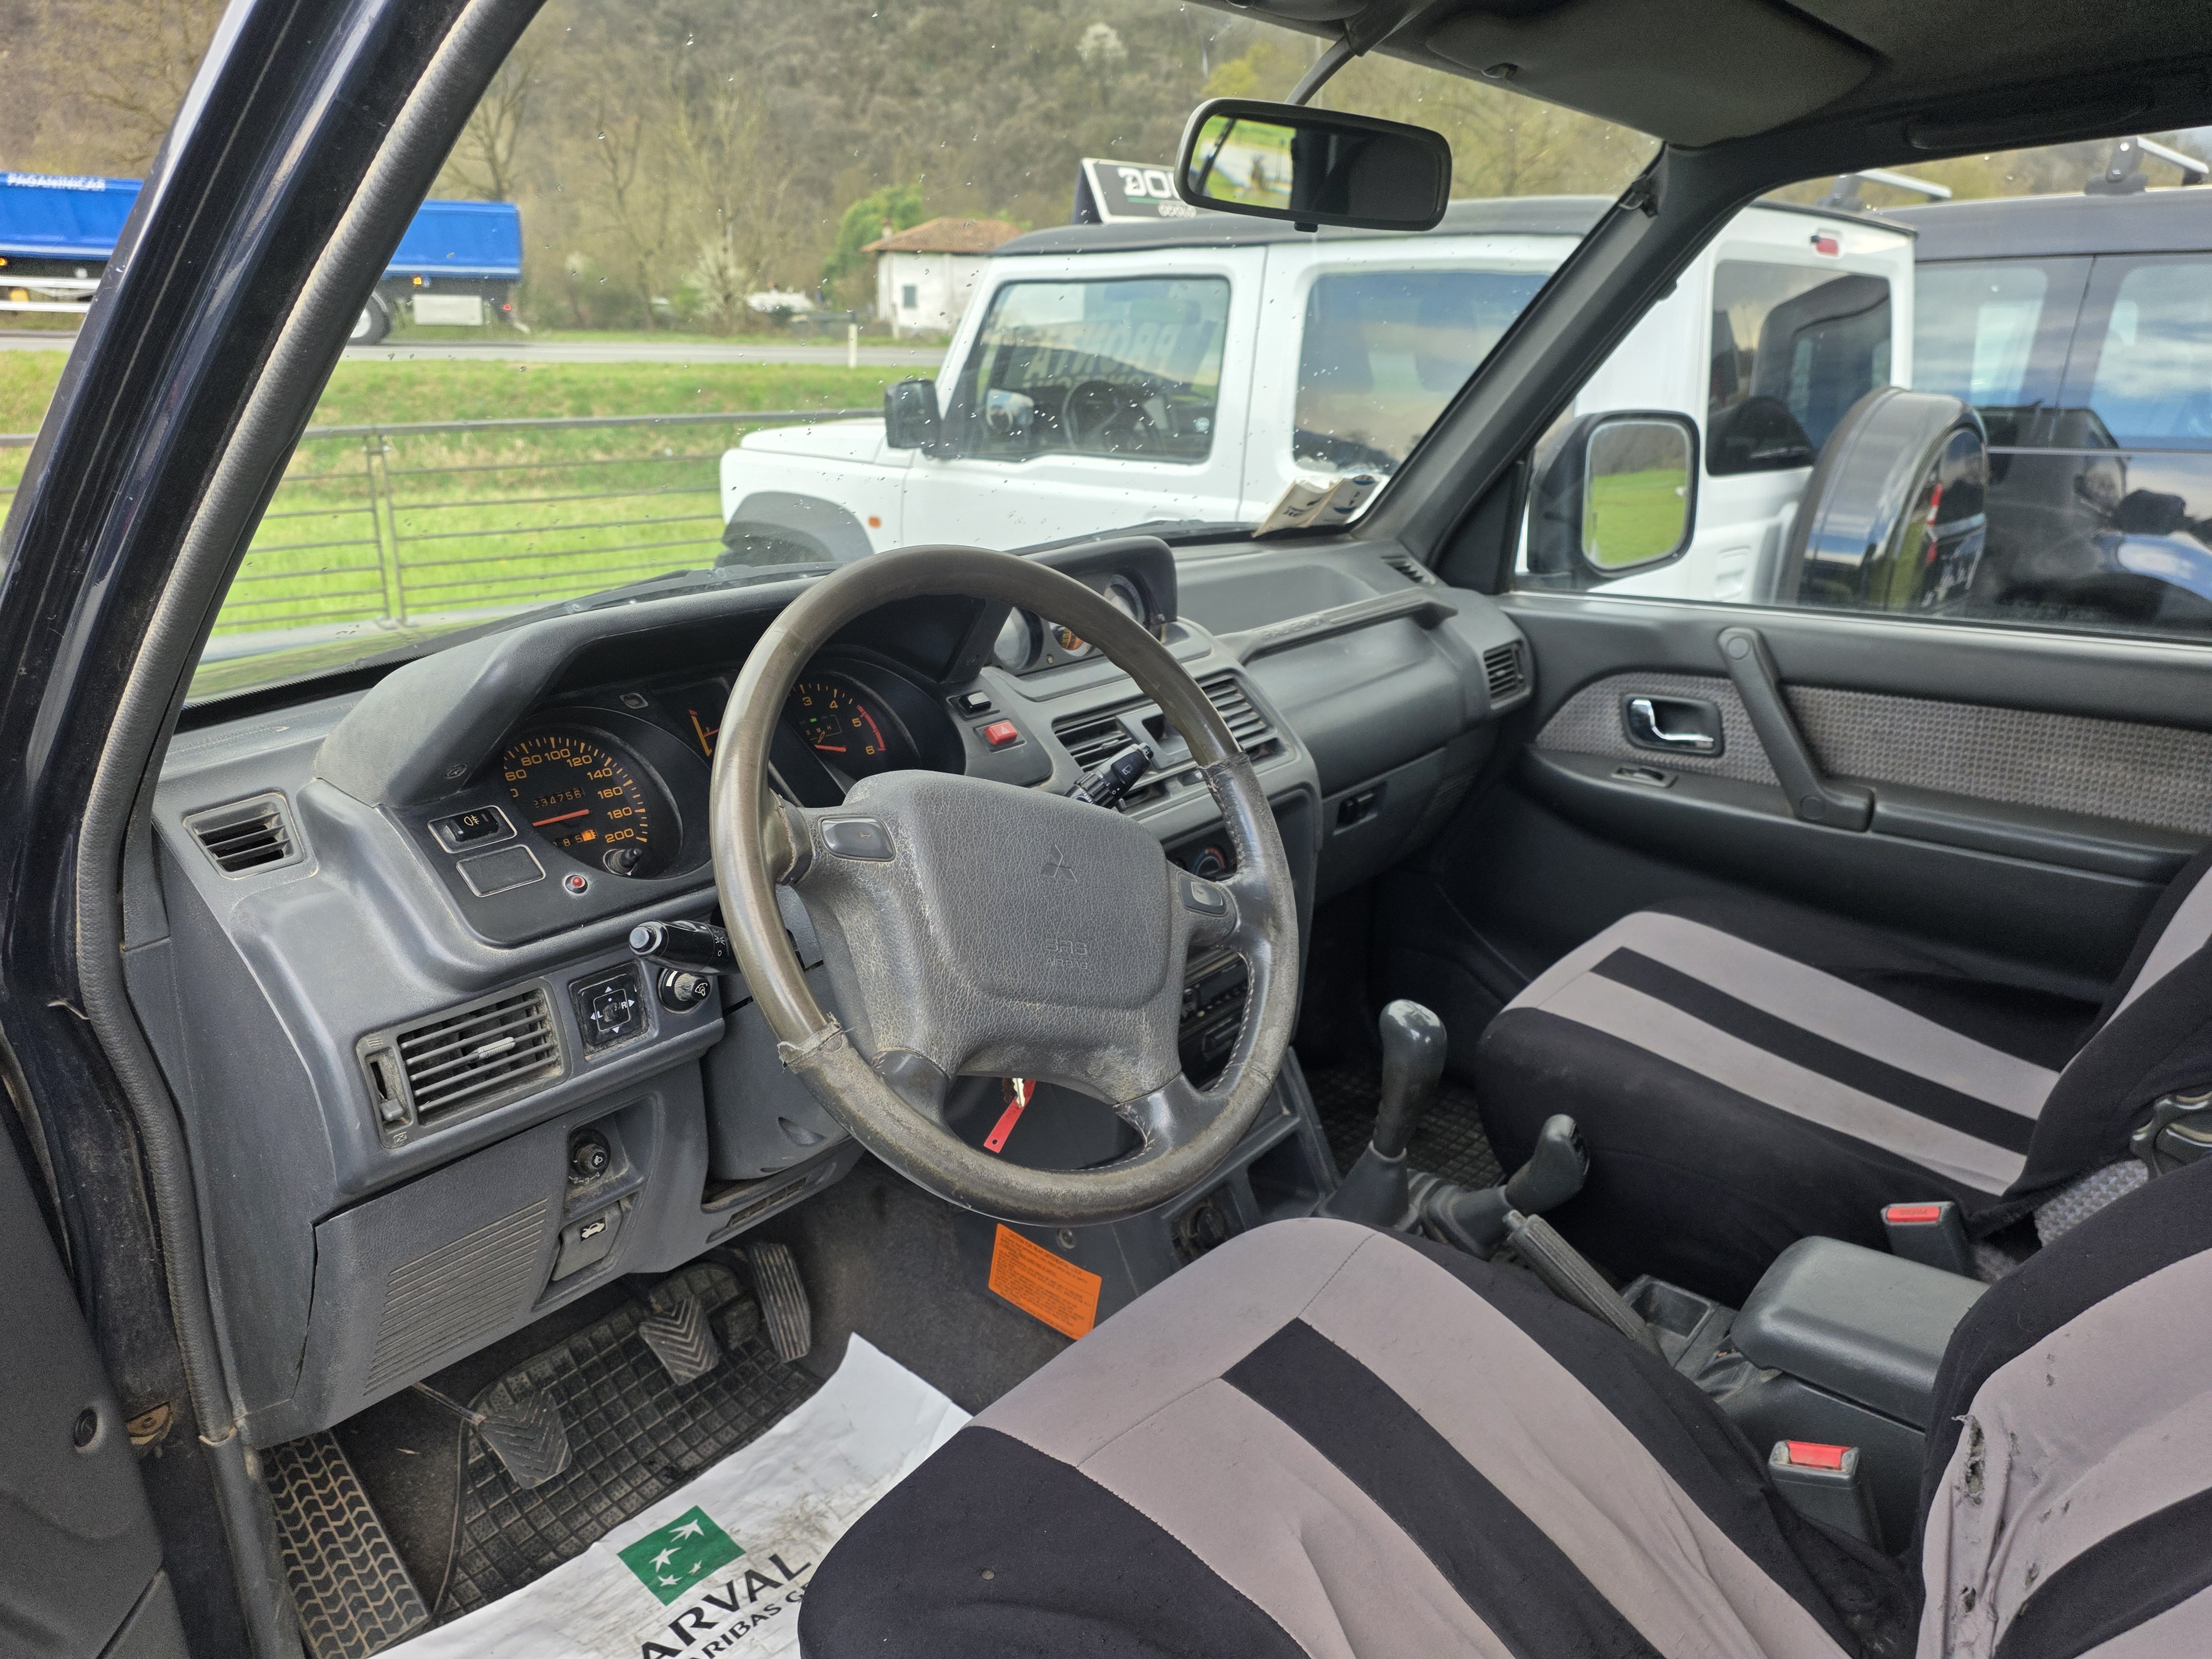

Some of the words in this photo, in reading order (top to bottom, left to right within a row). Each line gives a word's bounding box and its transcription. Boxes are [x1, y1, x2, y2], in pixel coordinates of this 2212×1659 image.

[802, 696, 812, 706] 3
[830, 700, 838, 708] 4
[852, 718, 862, 727] 5
[545, 748, 571, 761] 100
[865, 745, 875, 755] 6
[521, 754, 542, 766] 80
[566, 755, 592, 768] 120
[505, 769, 527, 781] 60
[587, 768, 613, 780] 140
[597, 786, 623, 799] 160
[607, 806, 633, 820] 180
[604, 828, 634, 843] 200
[1045, 938, 1088, 956] SRS
[620, 1001, 628, 1010] R
[597, 1010, 603, 1019] L
[641, 1553, 812, 1659] ARVAL
[690, 1604, 782, 1659] RIBAS
